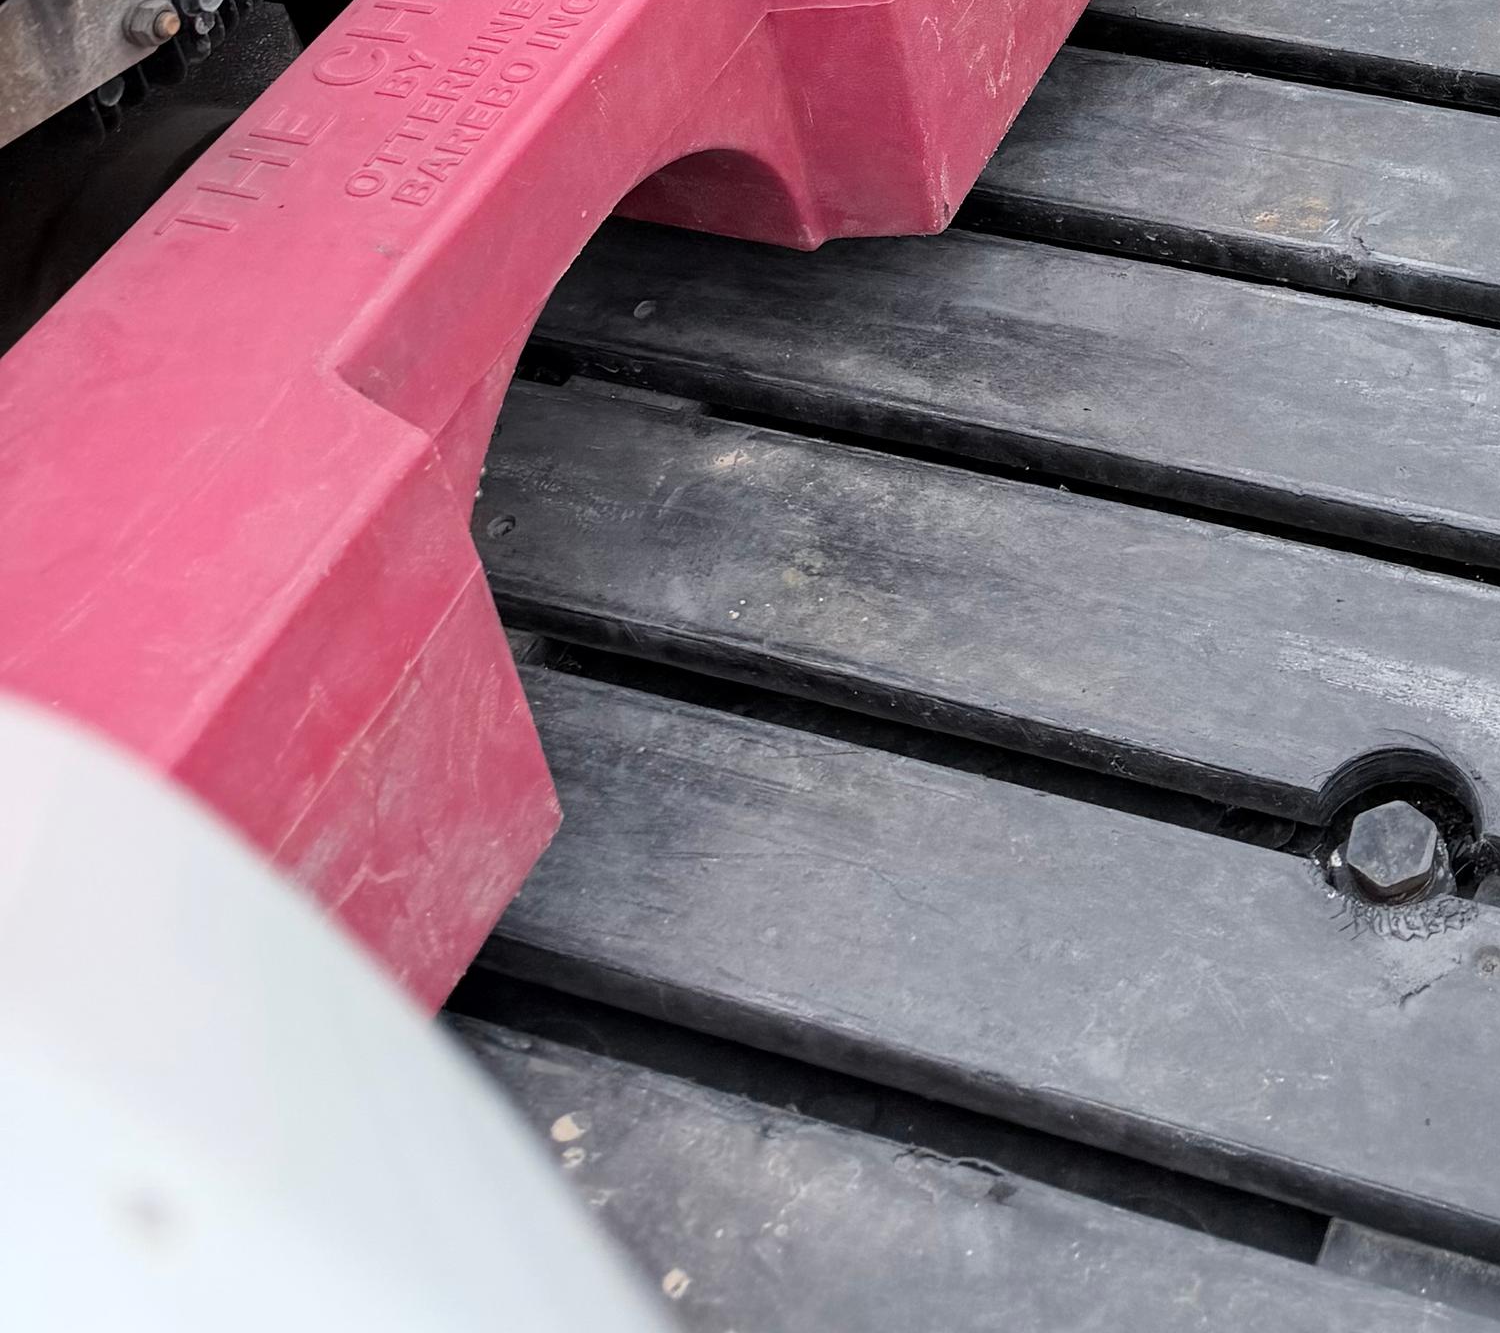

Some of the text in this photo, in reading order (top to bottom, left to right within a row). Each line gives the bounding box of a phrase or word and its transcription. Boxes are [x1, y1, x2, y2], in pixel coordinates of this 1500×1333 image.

[374, 49, 438, 99] BY
[391, 57, 541, 208] BAREBO
[153, 103, 340, 237] THE
